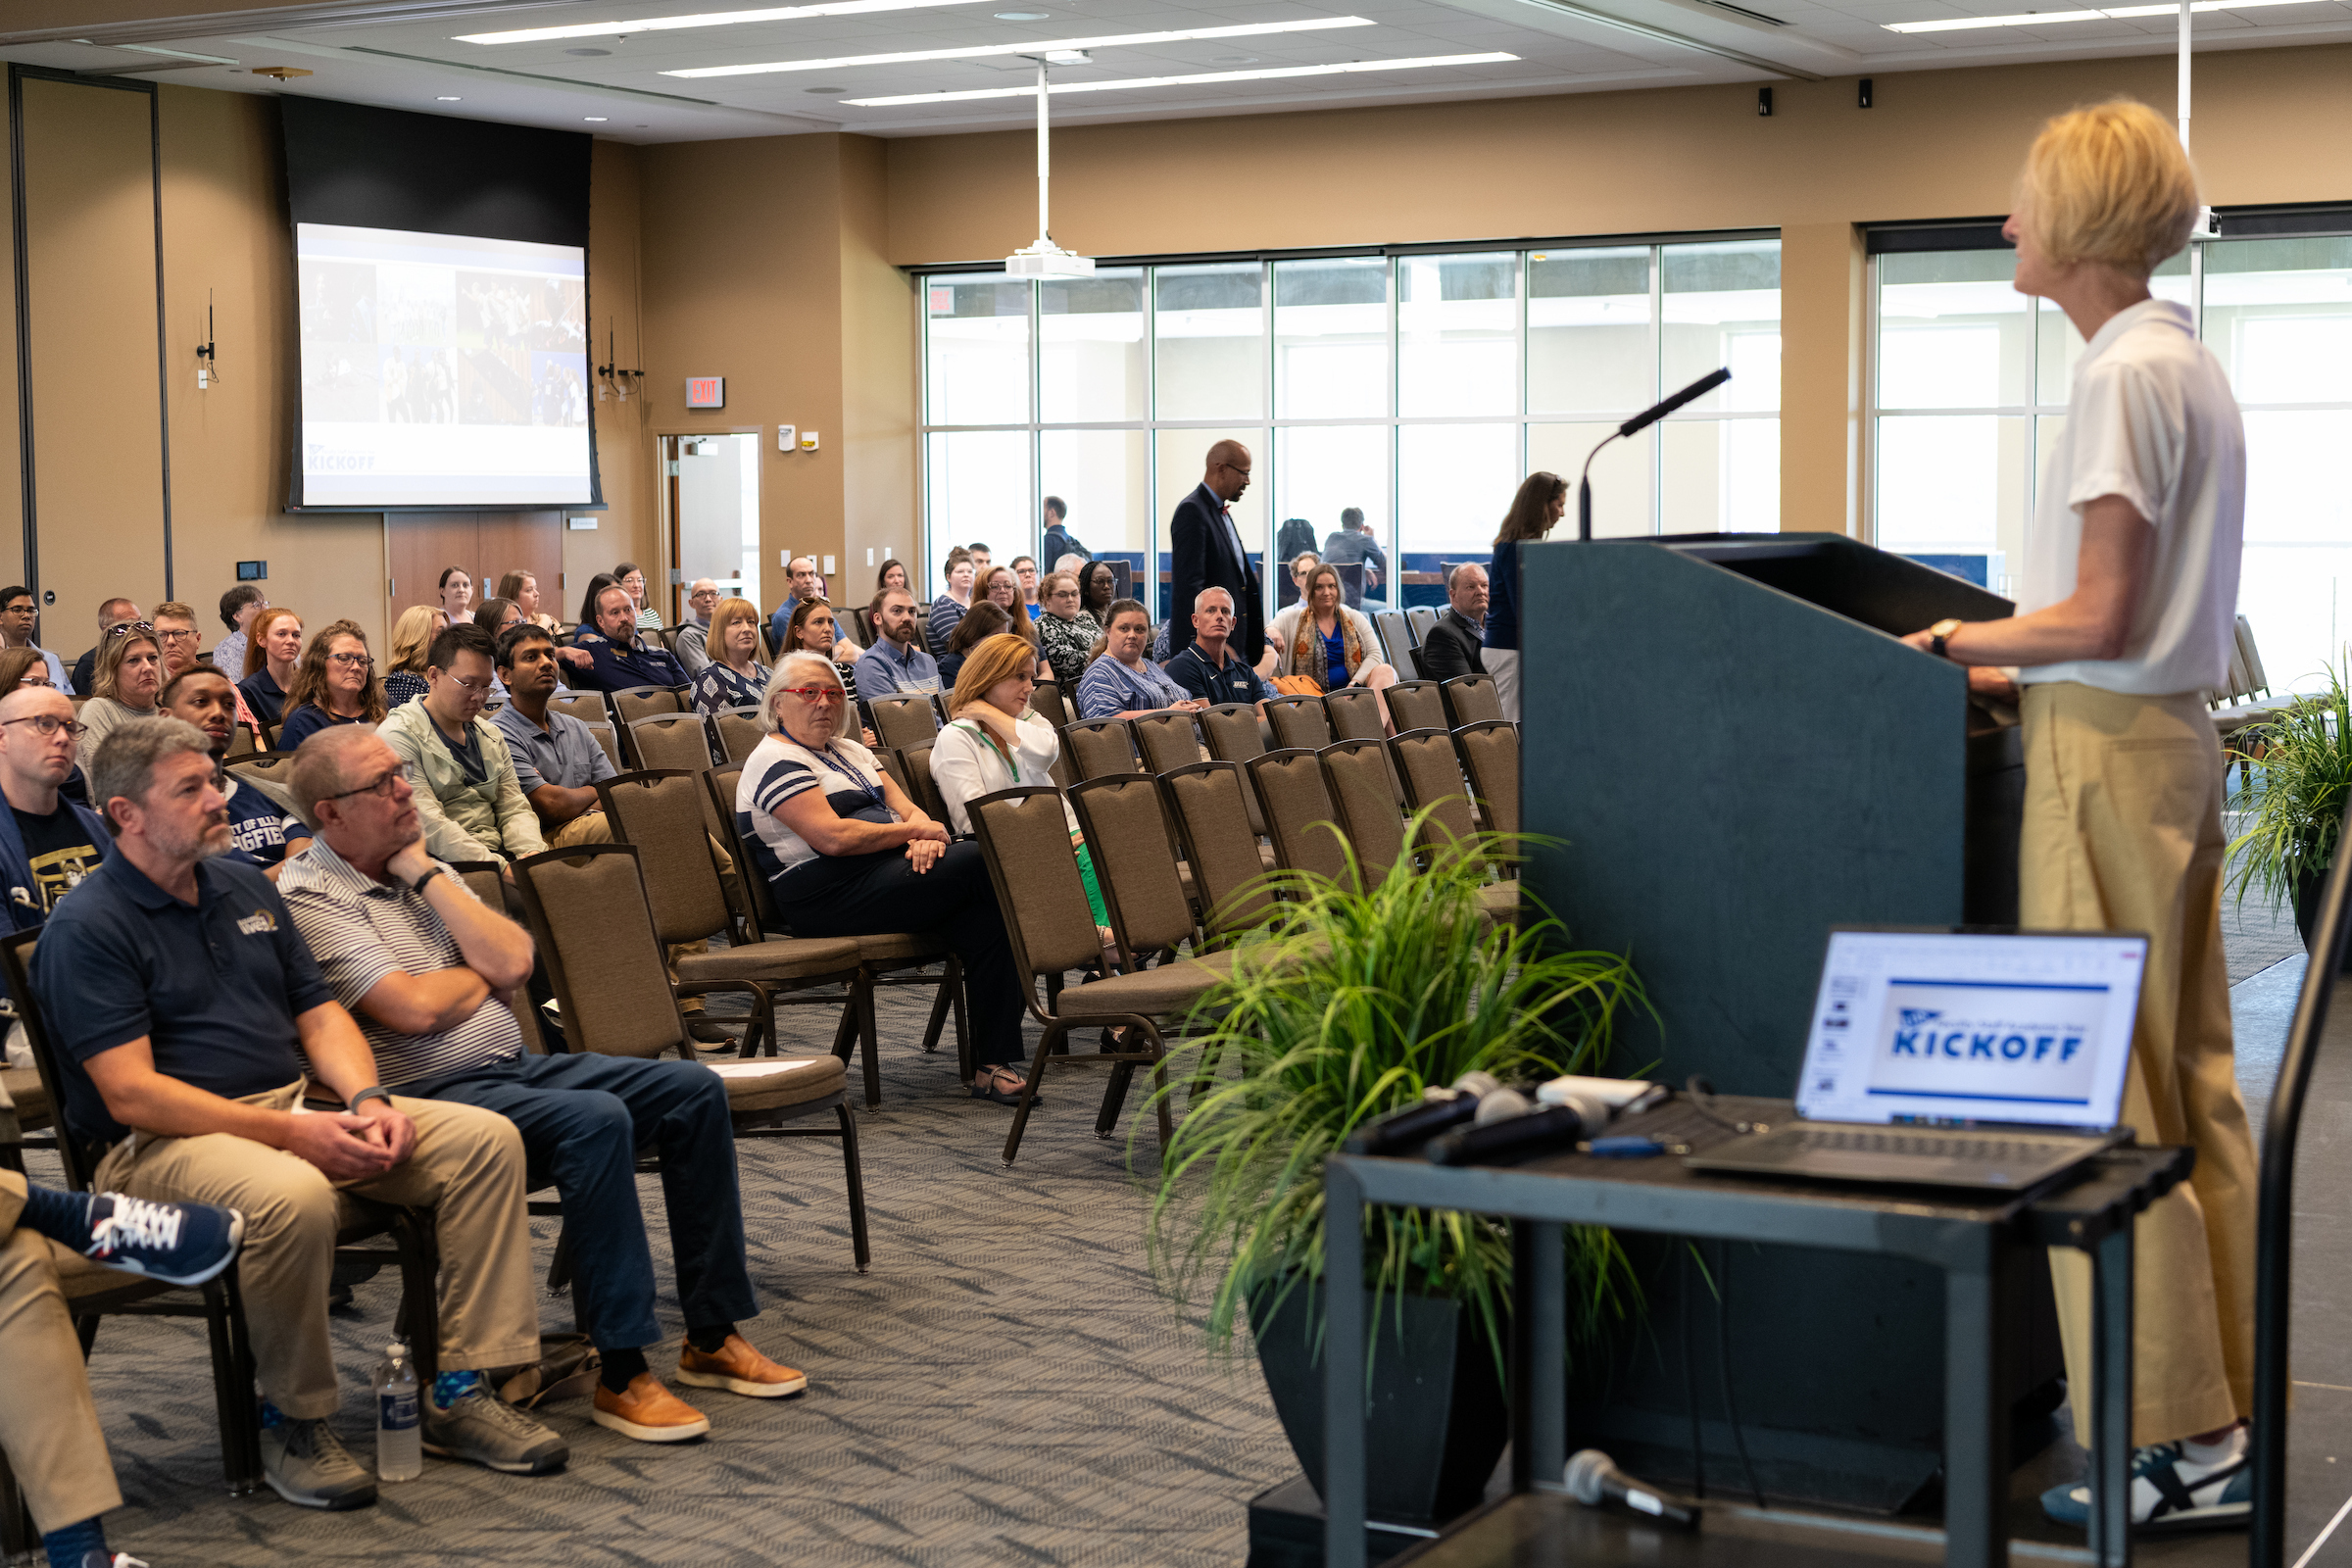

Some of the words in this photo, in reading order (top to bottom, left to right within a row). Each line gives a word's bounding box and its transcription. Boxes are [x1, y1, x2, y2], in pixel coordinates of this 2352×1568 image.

[693, 380, 716, 403] EXIT
[309, 456, 375, 470] KICKOFF
[242, 818, 257, 831] OF
[1891, 1030, 2082, 1061] KICKOFF
